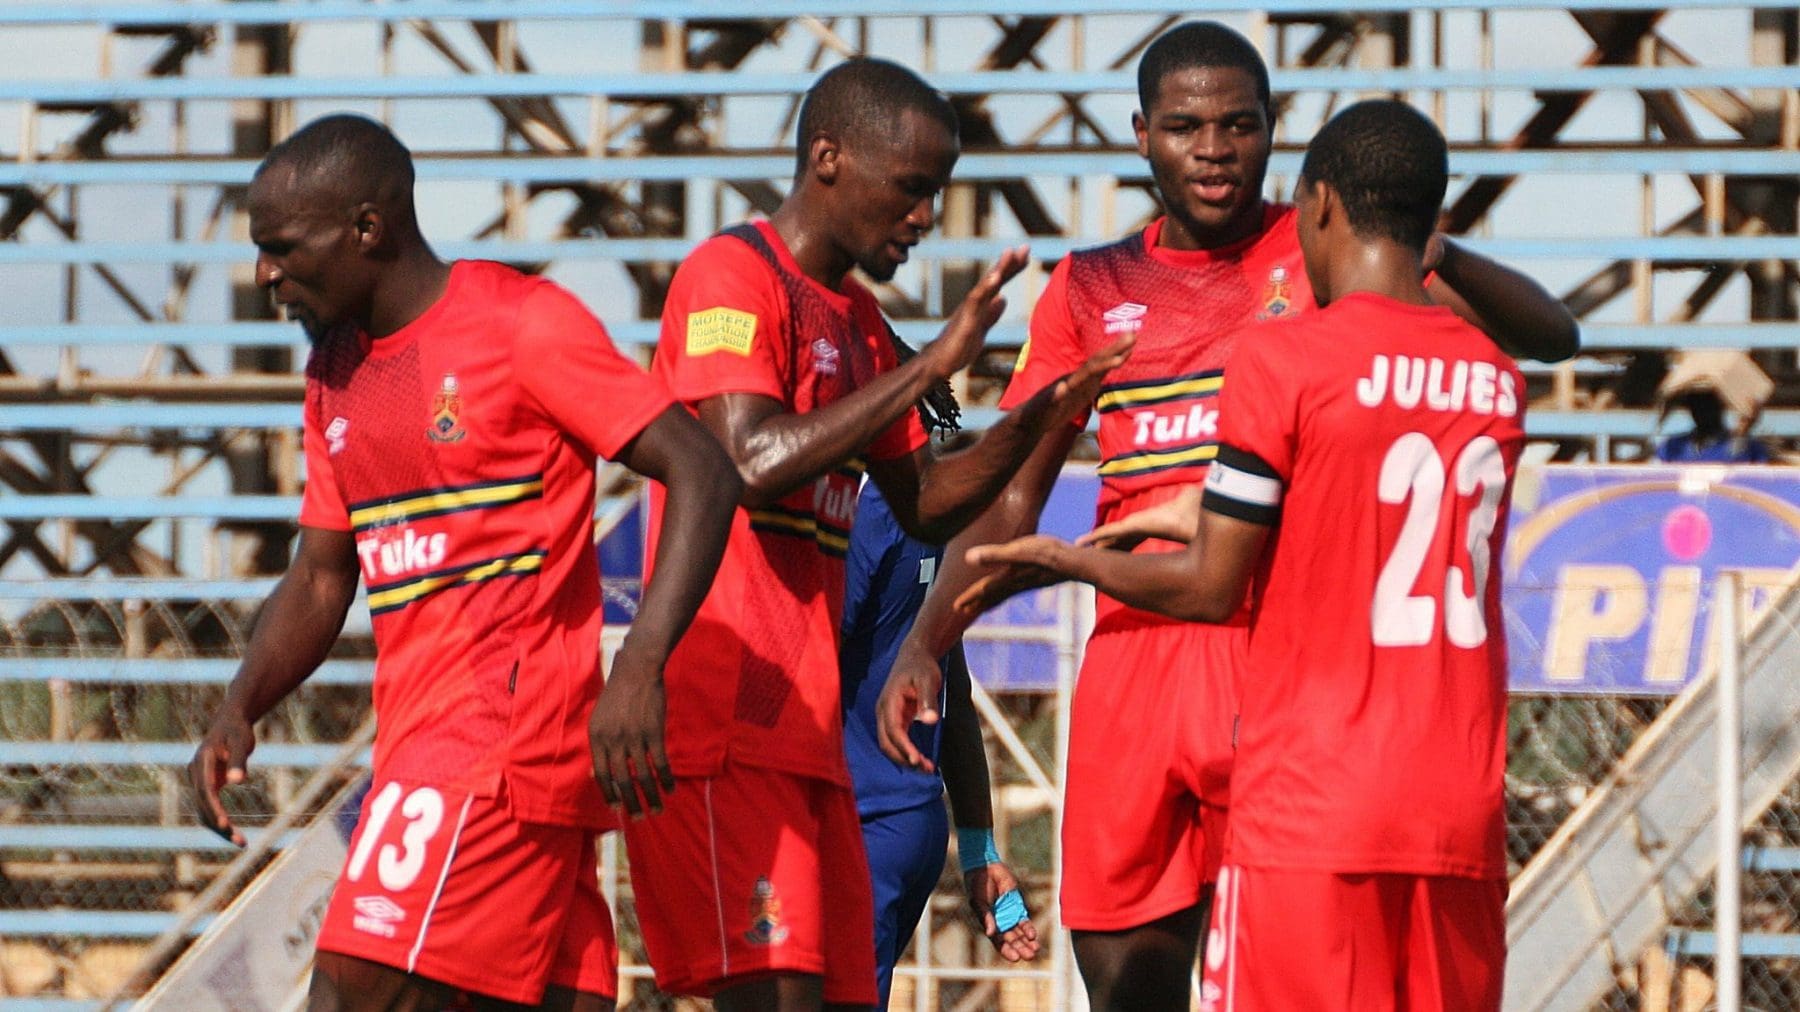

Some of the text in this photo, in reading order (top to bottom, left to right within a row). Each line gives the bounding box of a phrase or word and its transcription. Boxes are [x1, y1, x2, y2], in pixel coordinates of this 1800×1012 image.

[1357, 354, 1517, 418] JULIES
[357, 528, 448, 579] Tuks
[1371, 432, 1506, 649] 23
[347, 781, 444, 892] 13
